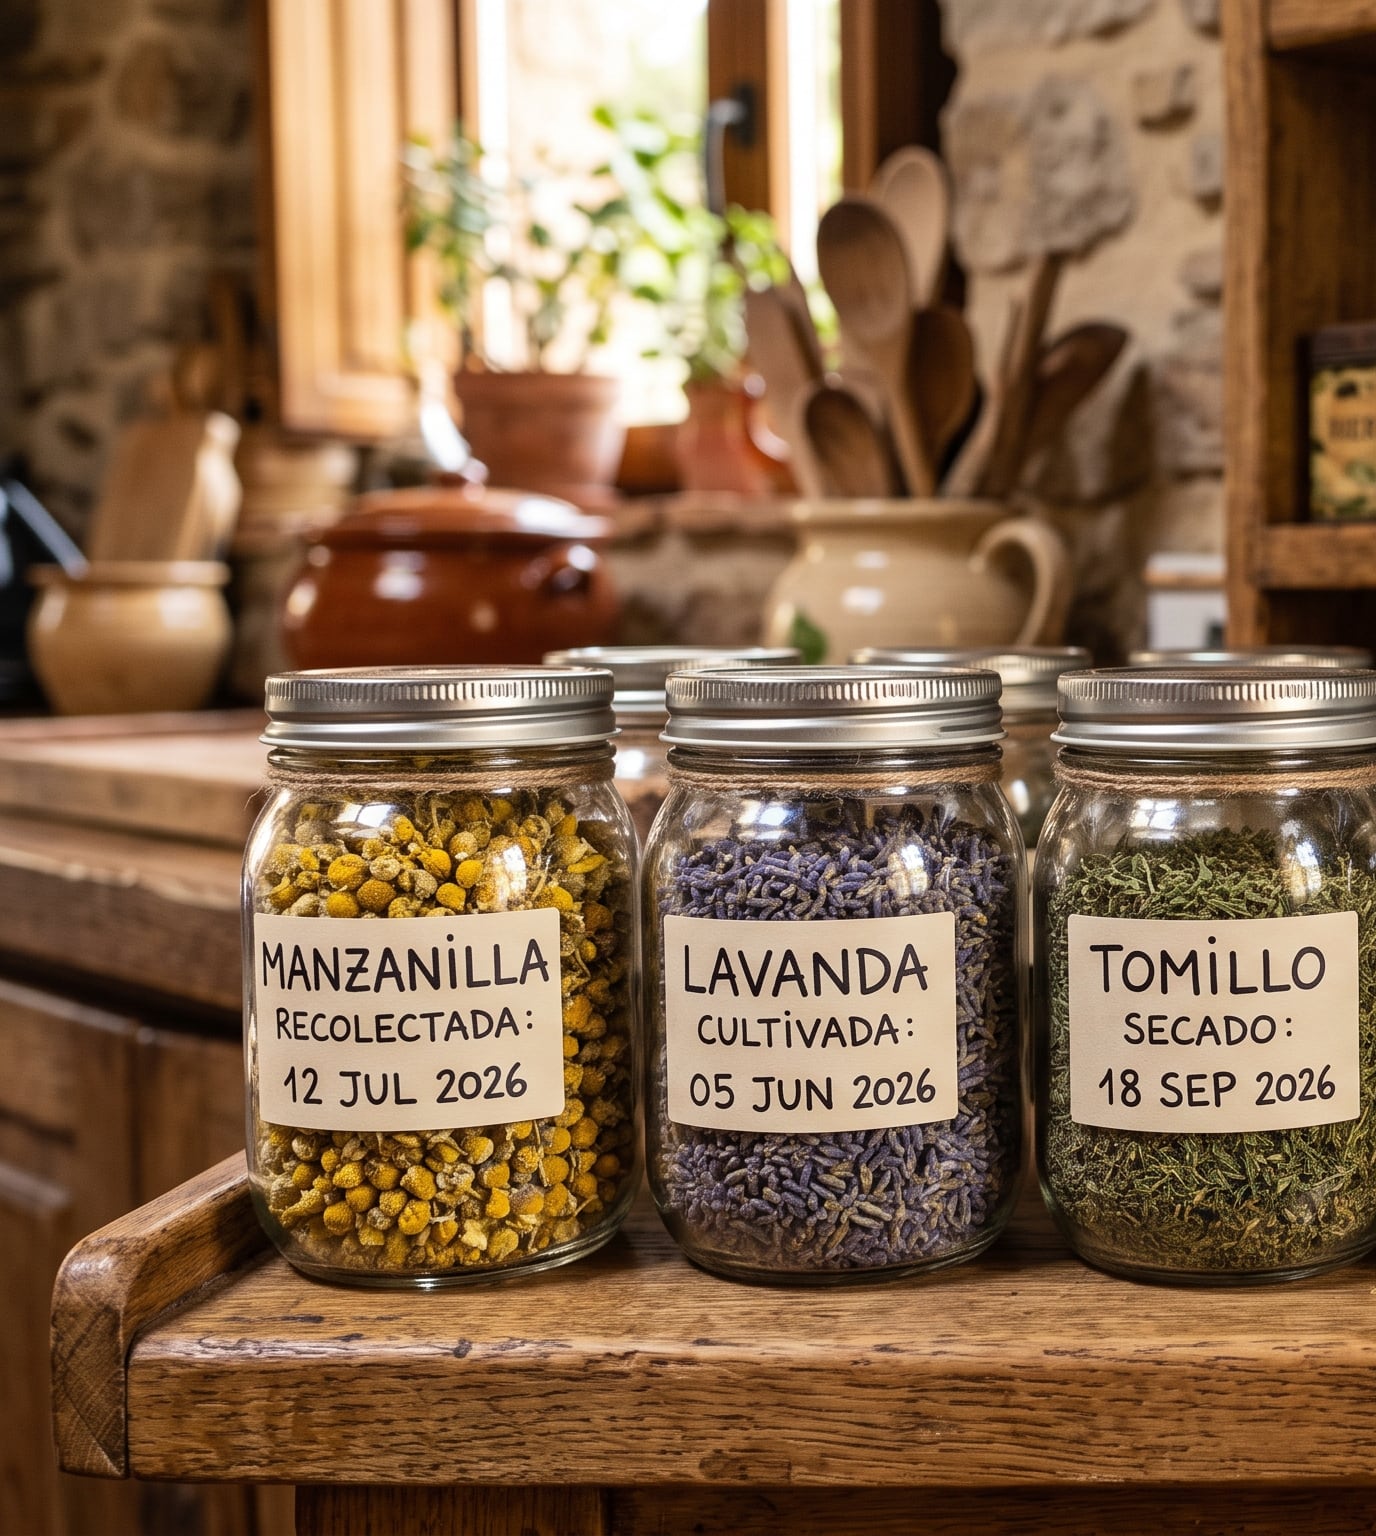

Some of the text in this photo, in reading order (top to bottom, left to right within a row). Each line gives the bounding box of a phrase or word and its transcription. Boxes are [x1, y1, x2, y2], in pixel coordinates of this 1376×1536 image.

[684, 943, 929, 998] LAVANDA
[275, 1006, 533, 1043] RECOLECTADA:
[1123, 1012, 1292, 1047] SECADO:
[283, 1061, 528, 1108] 12 JUL 2026
[689, 1067, 936, 1113] 05 JUN 2026
[1098, 1064, 1336, 1108] 18 SEP 2026
